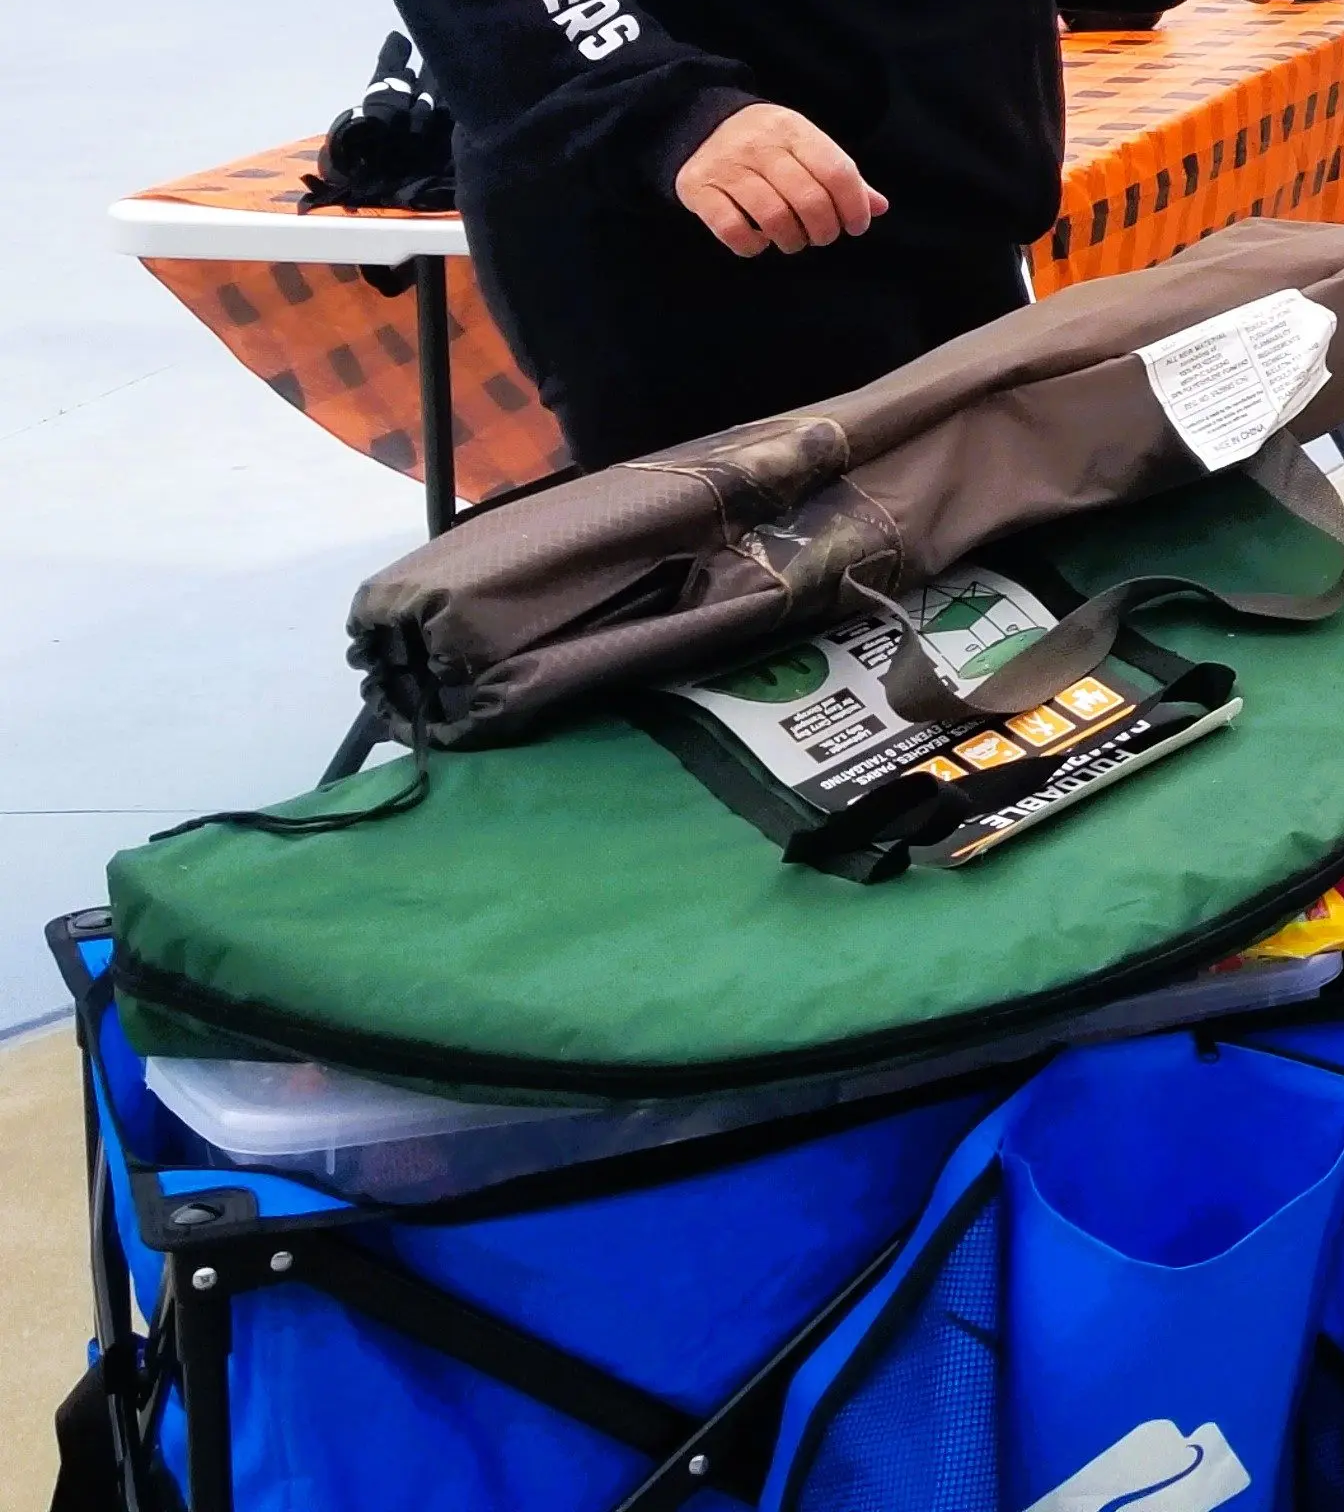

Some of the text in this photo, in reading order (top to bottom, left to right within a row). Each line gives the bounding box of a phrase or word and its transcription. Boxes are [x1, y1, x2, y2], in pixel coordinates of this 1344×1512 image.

[1240, 424, 1265, 441] CHINA
[893, 724, 944, 750] EVENTS,
[820, 751, 888, 791] TAILGATING
[852, 762, 898, 787] PARKS,
[979, 748, 1137, 829] FOLDABLE
